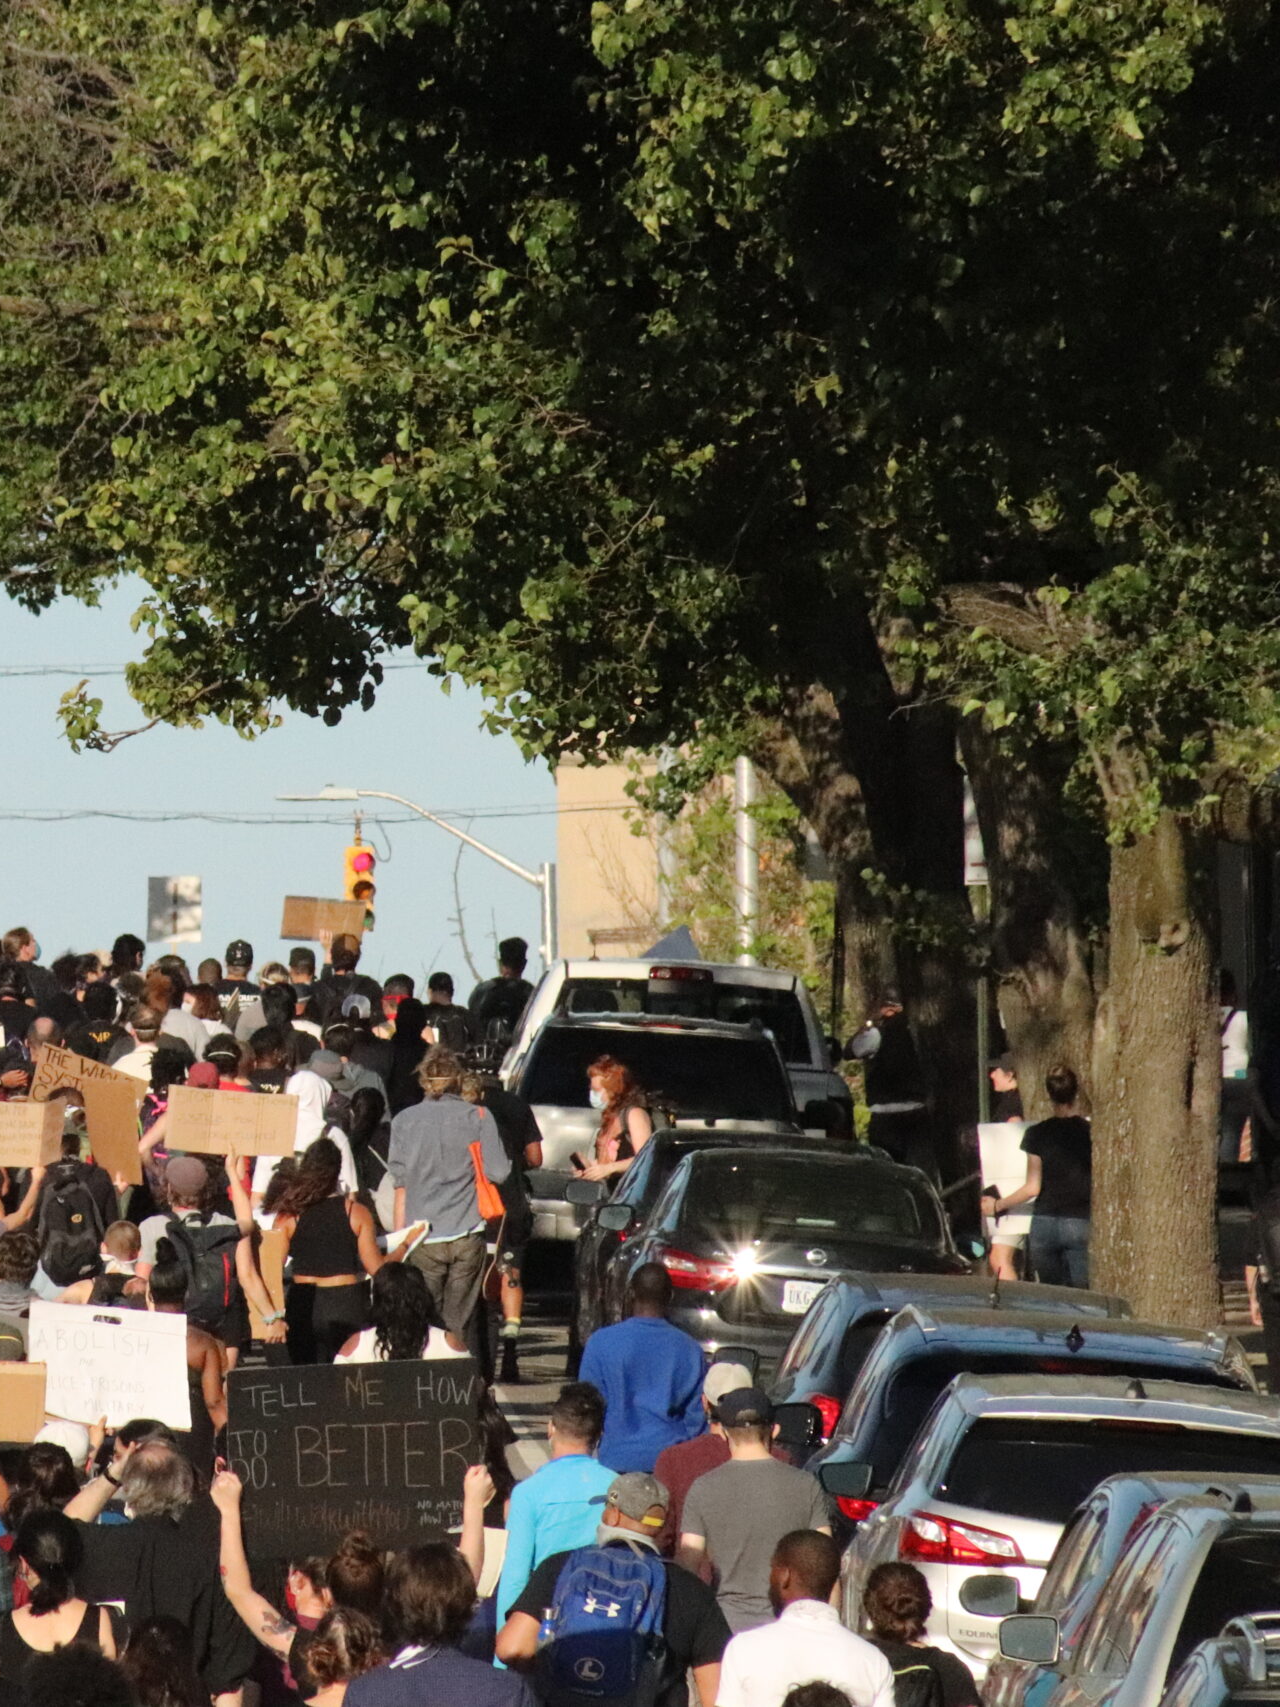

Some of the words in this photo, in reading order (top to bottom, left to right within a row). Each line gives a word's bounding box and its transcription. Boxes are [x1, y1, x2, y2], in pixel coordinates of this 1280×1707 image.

[44, 1044, 72, 1070] THE
[36, 1327, 151, 1357] ABOLISH
[241, 1381, 317, 1416] TELL
[345, 1367, 385, 1410] ME
[416, 1369, 476, 1409] HOW
[229, 1430, 268, 1457] TO
[294, 1417, 473, 1488] BETTER
